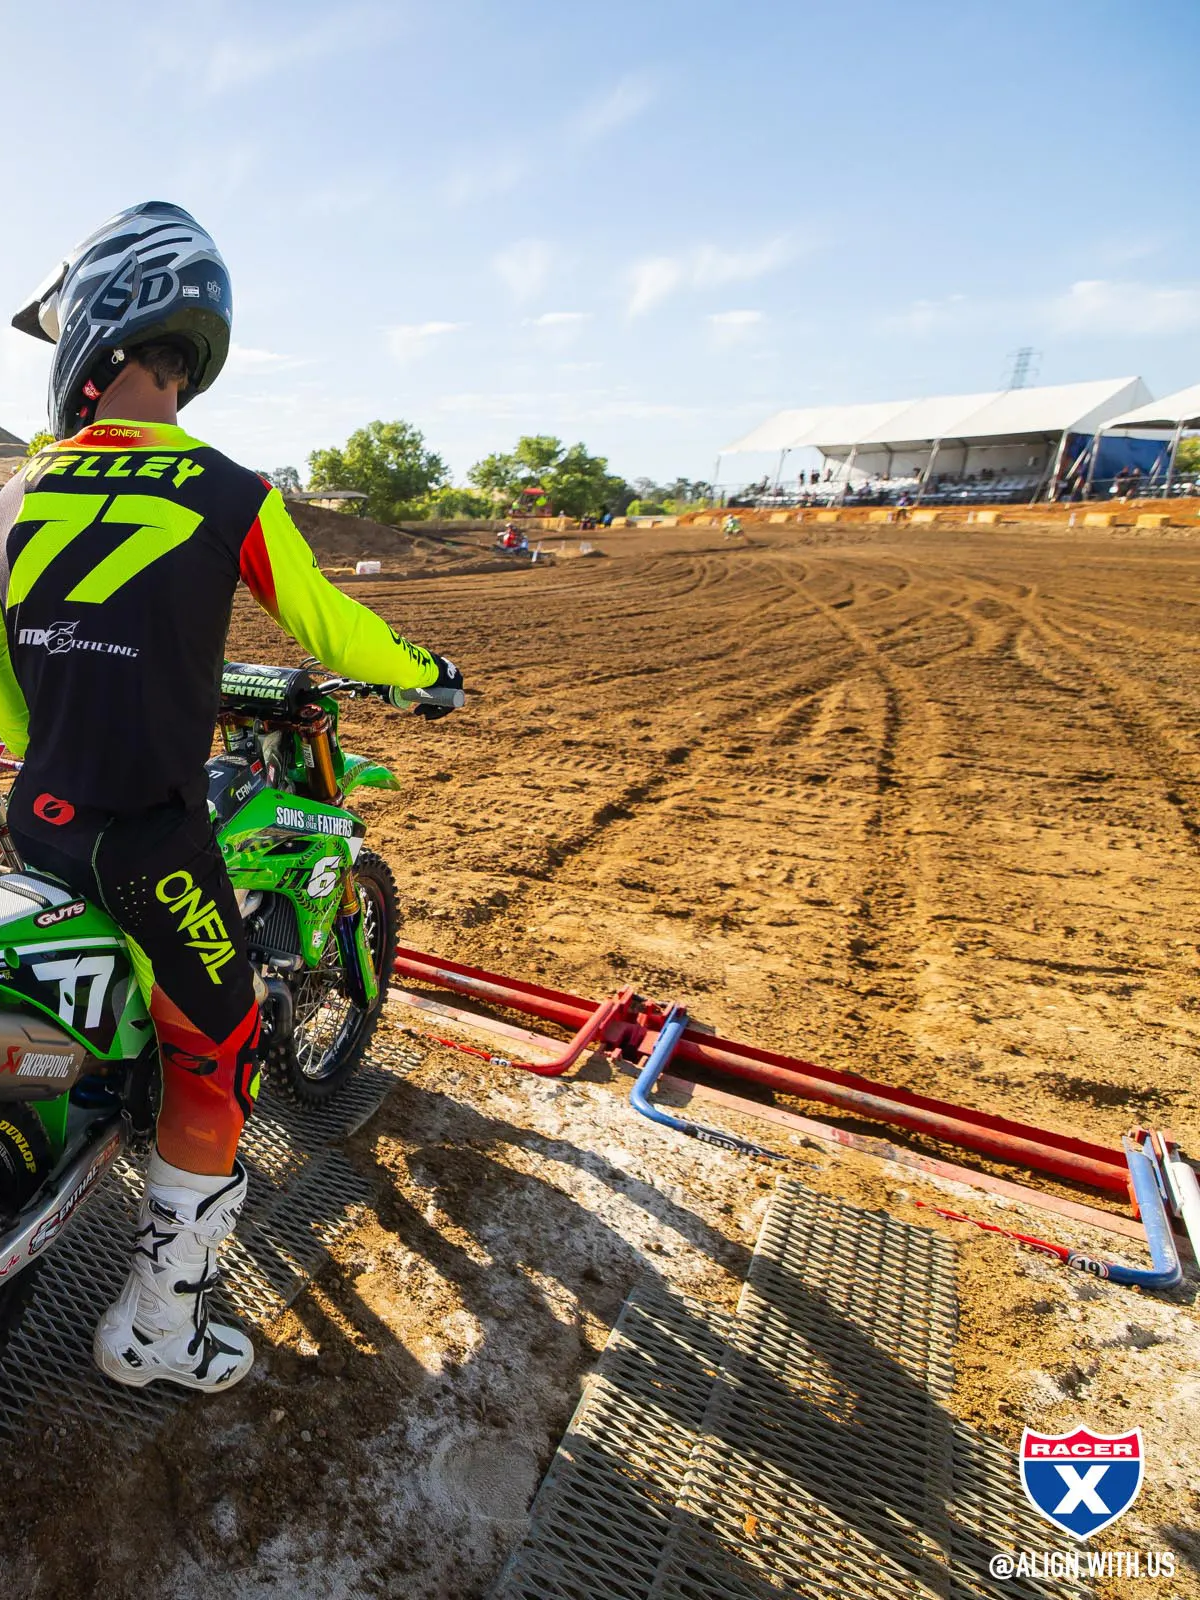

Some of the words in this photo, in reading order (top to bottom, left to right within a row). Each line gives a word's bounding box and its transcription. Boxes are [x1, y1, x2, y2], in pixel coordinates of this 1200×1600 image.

[109, 428, 143, 438] ONEAL
[20, 455, 205, 489] KELLEY
[6, 491, 205, 611] 77
[71, 640, 140, 658] RACING
[220, 684, 286, 700] RENTHAL
[222, 673, 288, 688] RENTHAL
[276, 806, 304, 829] SONS
[318, 814, 353, 838] FATHERS
[307, 855, 340, 898] 6
[37, 902, 85, 926] GUTS
[155, 870, 236, 985] ONEAL
[31, 953, 115, 1028] 77
[17, 1053, 74, 1078] AKRAPOVIČ
[1076, 1258, 1101, 1276] 19
